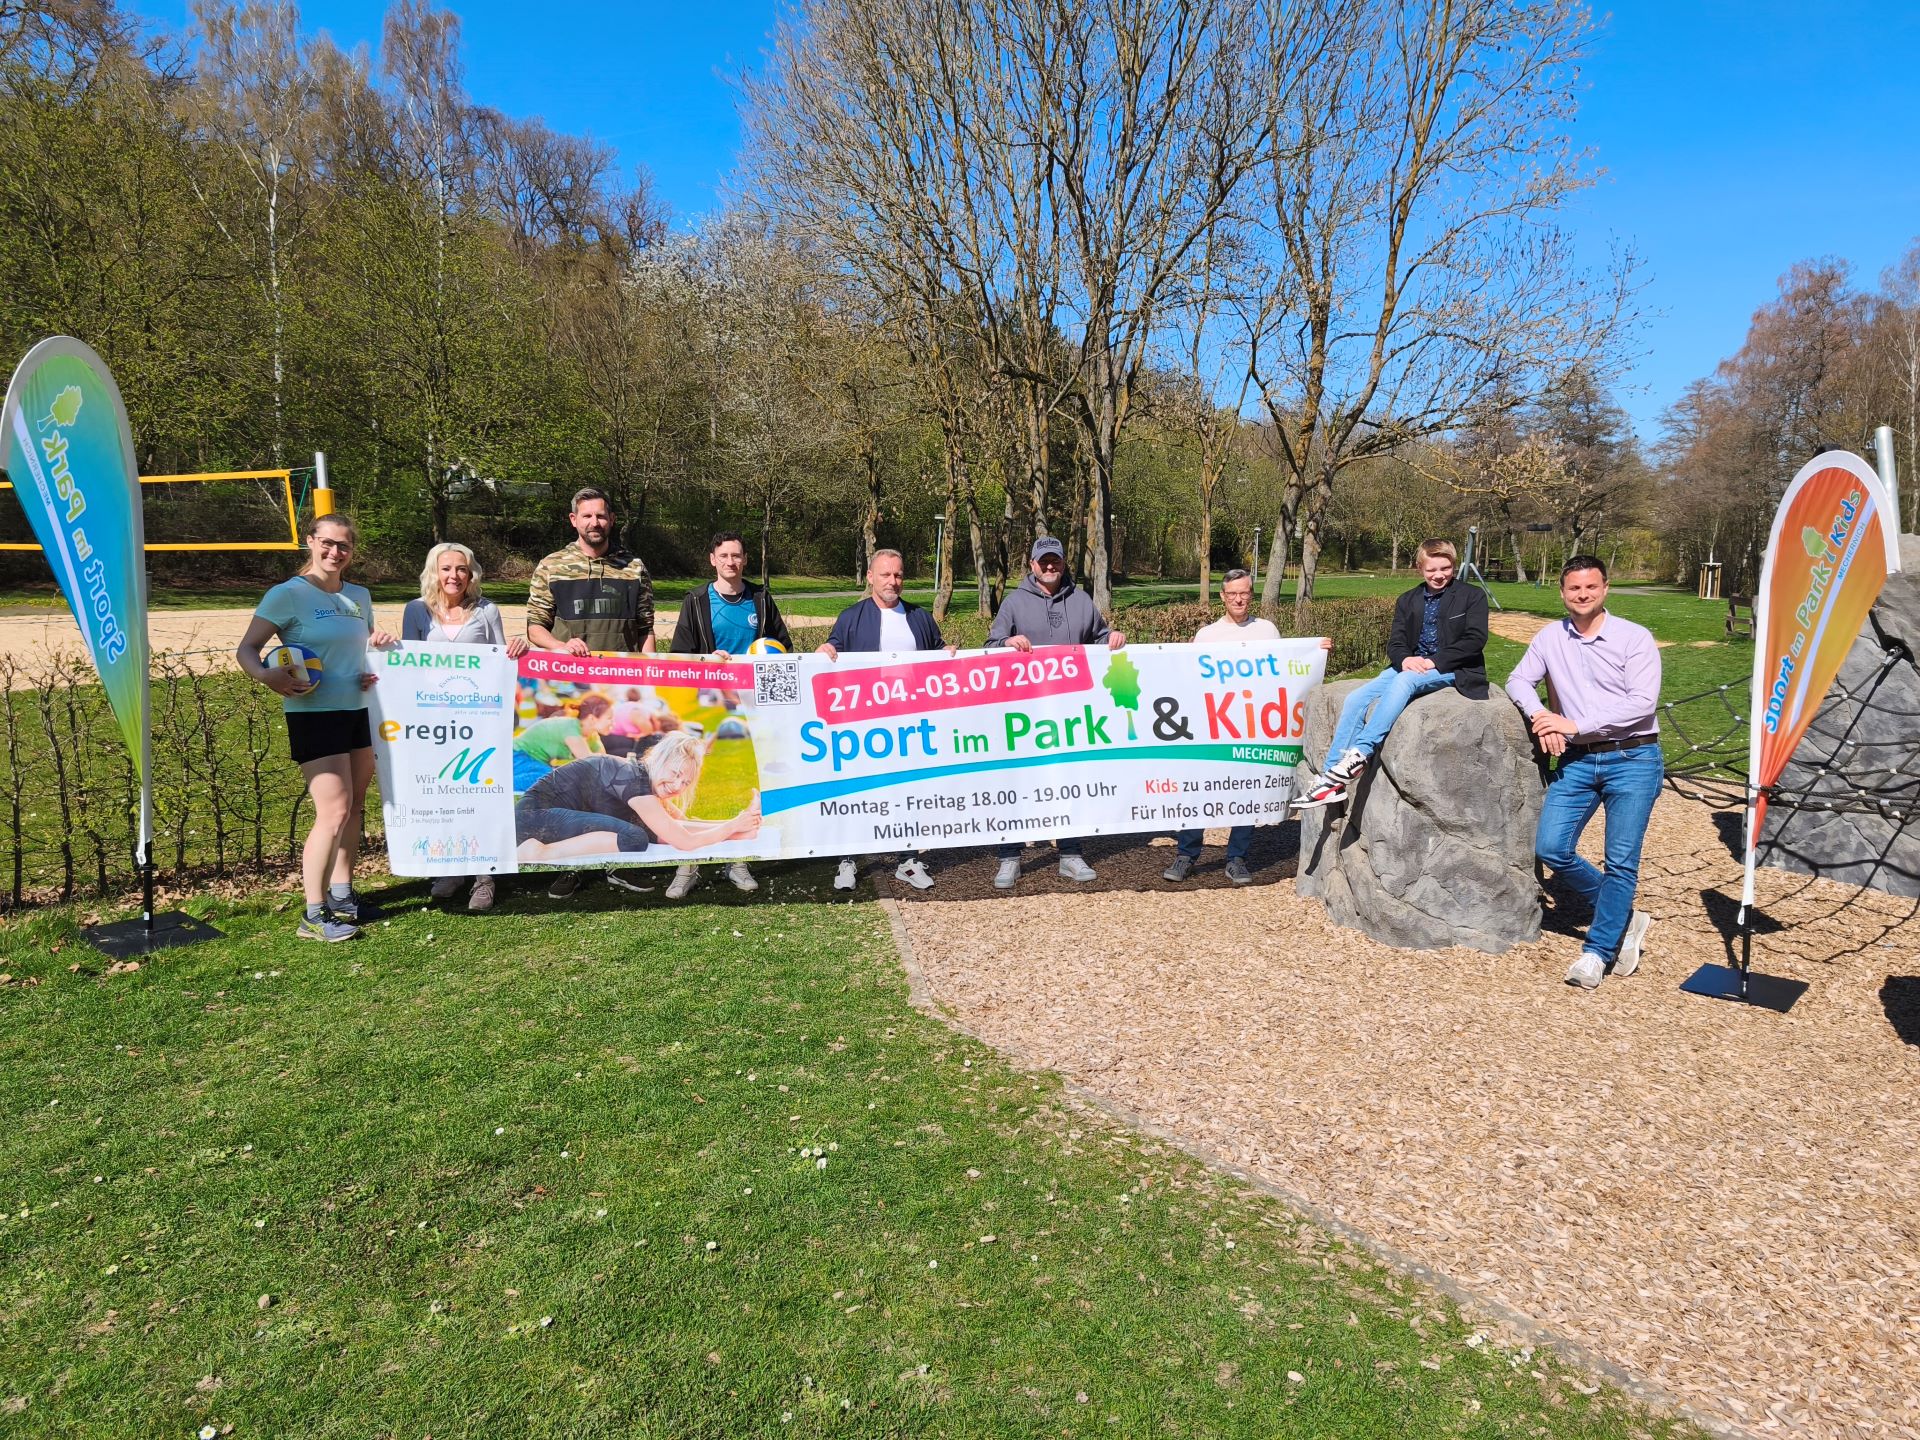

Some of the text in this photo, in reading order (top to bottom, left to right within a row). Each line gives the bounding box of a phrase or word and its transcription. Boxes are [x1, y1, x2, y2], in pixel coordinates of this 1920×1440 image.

[1837, 522, 1867, 581] MECHERNICH
[1765, 488, 1862, 734] Sport im Park Kids
[387, 651, 481, 669] BARMER
[527, 659, 738, 682] QR Code scannen für mehr Infos.
[1198, 653, 1312, 685] Sport für
[827, 655, 1079, 713] 27.04.-03.07.2026
[416, 690, 500, 704] KreisSportBund
[1204, 686, 1305, 740] Kids
[800, 696, 1194, 772] Sport im Park &
[1232, 746, 1299, 765] MECHERNICH
[415, 774, 437, 784] Wir
[422, 783, 504, 795] in Mechernich
[1145, 779, 1178, 794] Kids
[1183, 780, 1200, 792] zu
[1204, 776, 1261, 791] anderen
[819, 800, 890, 817] Montag
[906, 795, 966, 812] Freitag
[971, 790, 1018, 808] 18.00
[1033, 784, 1082, 803] 19.00
[1086, 781, 1118, 798] Uhr
[1131, 806, 1157, 821] Für
[1162, 803, 1198, 819] Infos
[1203, 802, 1224, 819] QR
[1228, 800, 1260, 815] Code
[873, 814, 1071, 840] Mühlenpark Kommern
